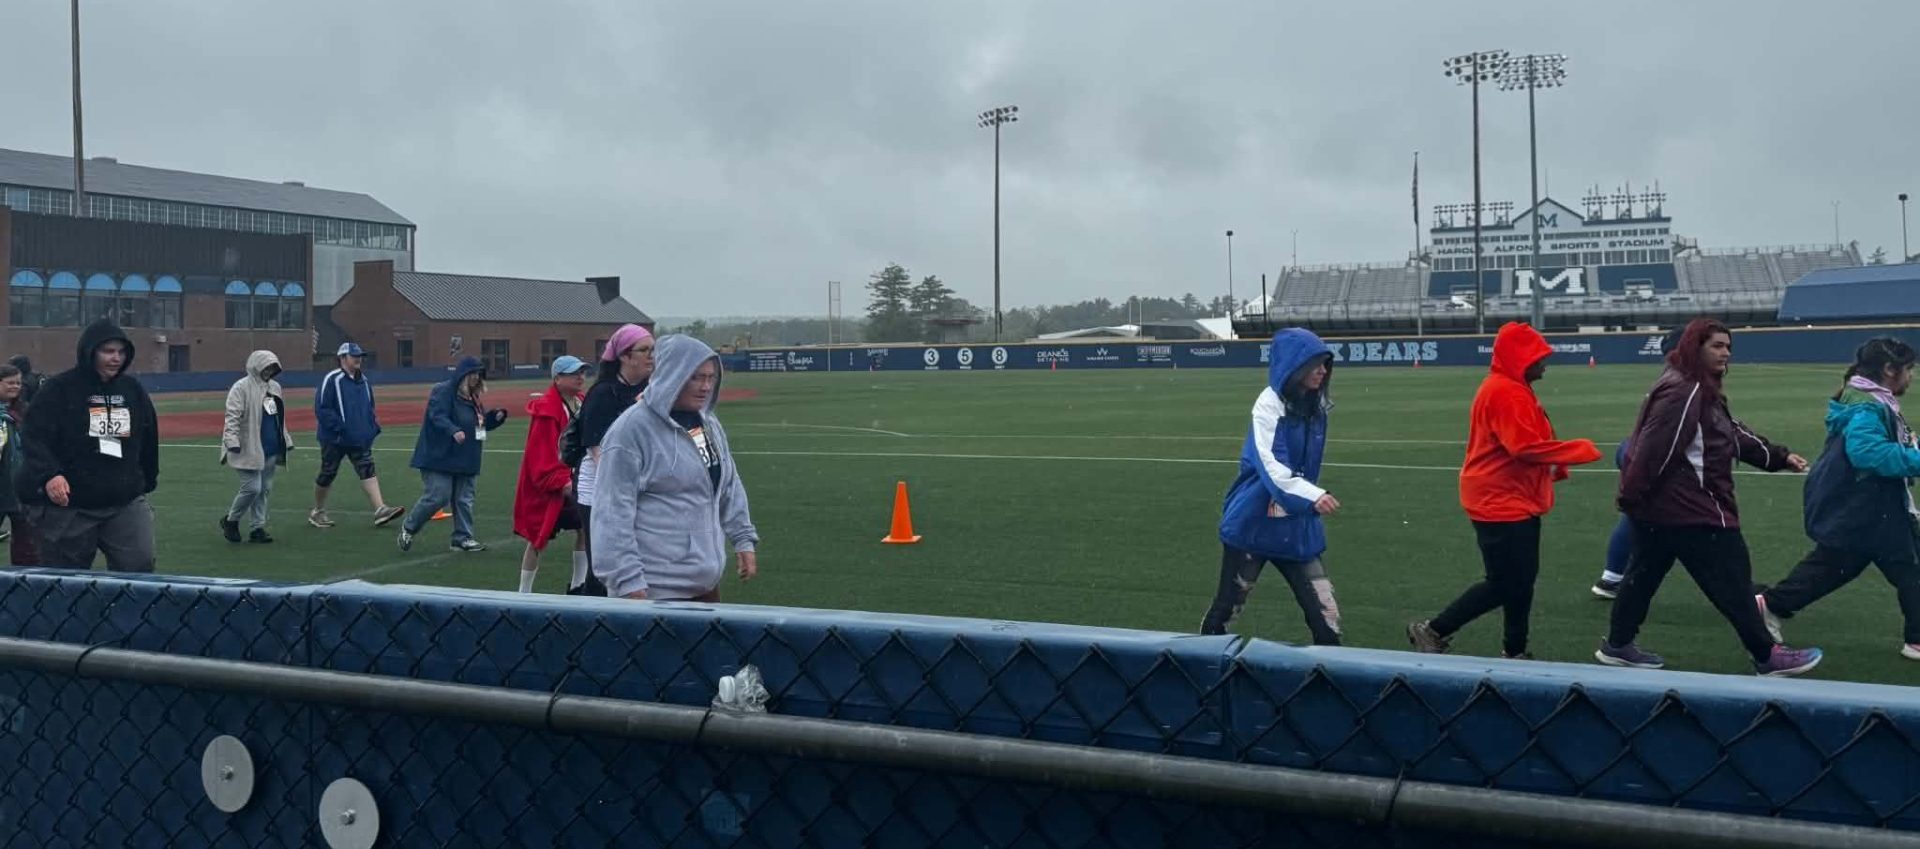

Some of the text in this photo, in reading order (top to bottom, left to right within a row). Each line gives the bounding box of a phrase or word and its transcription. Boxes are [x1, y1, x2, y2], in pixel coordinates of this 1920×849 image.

[1538, 213, 1558, 228] M
[1494, 244, 1541, 253] ALFON
[1551, 241, 1600, 250] SPORTS
[1608, 239, 1665, 248] STADIUM
[1515, 267, 1585, 295] M
[1349, 341, 1438, 361] BEARS
[99, 421, 122, 435] 362
